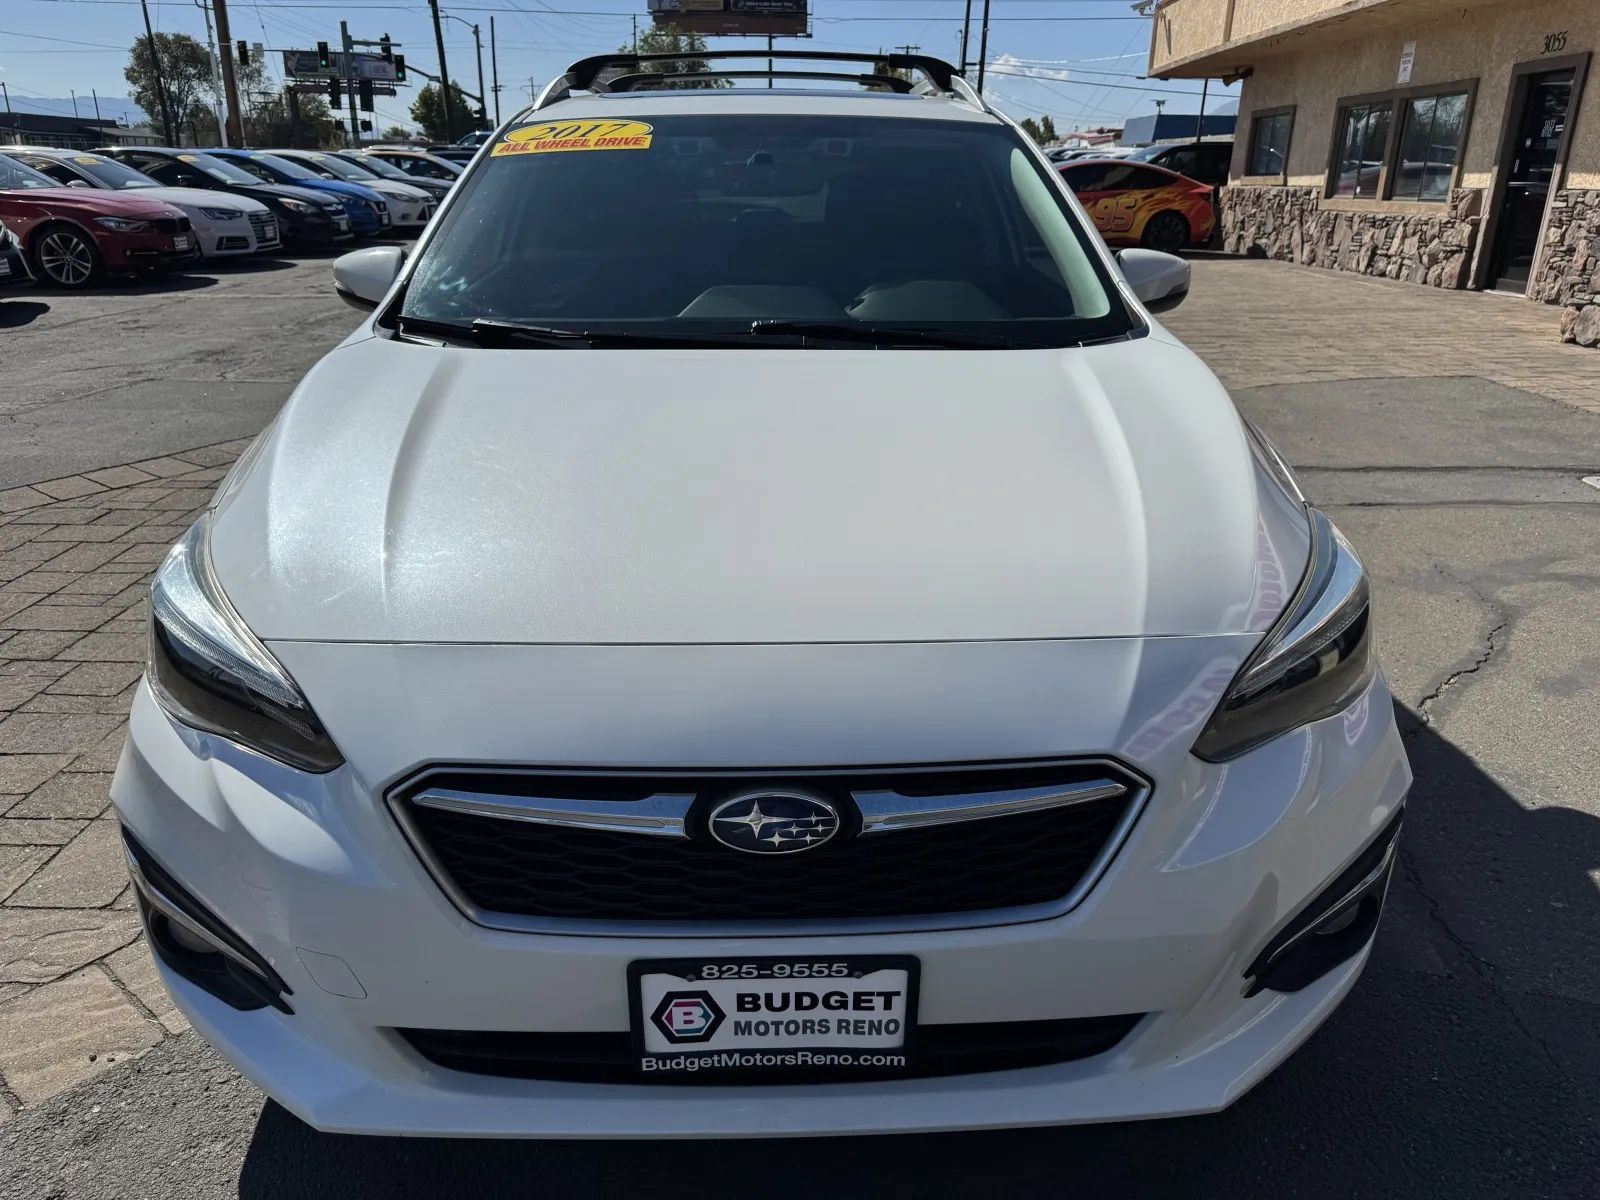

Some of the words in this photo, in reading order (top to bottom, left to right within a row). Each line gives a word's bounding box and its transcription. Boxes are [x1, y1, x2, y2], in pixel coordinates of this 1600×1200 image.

[1540, 30, 1568, 54] 3055
[528, 123, 631, 141] 2017
[498, 142, 530, 153] ALL
[535, 138, 589, 150] WHEEL
[593, 136, 647, 147] DRIVE
[1094, 198, 1136, 232] 95
[701, 963, 849, 979] 825-9555
[736, 990, 901, 1012] BUDGET
[733, 1019, 830, 1037] MOTORS
[837, 1018, 900, 1036] RENO
[642, 1051, 906, 1072] BudgetMotorsReno.com
